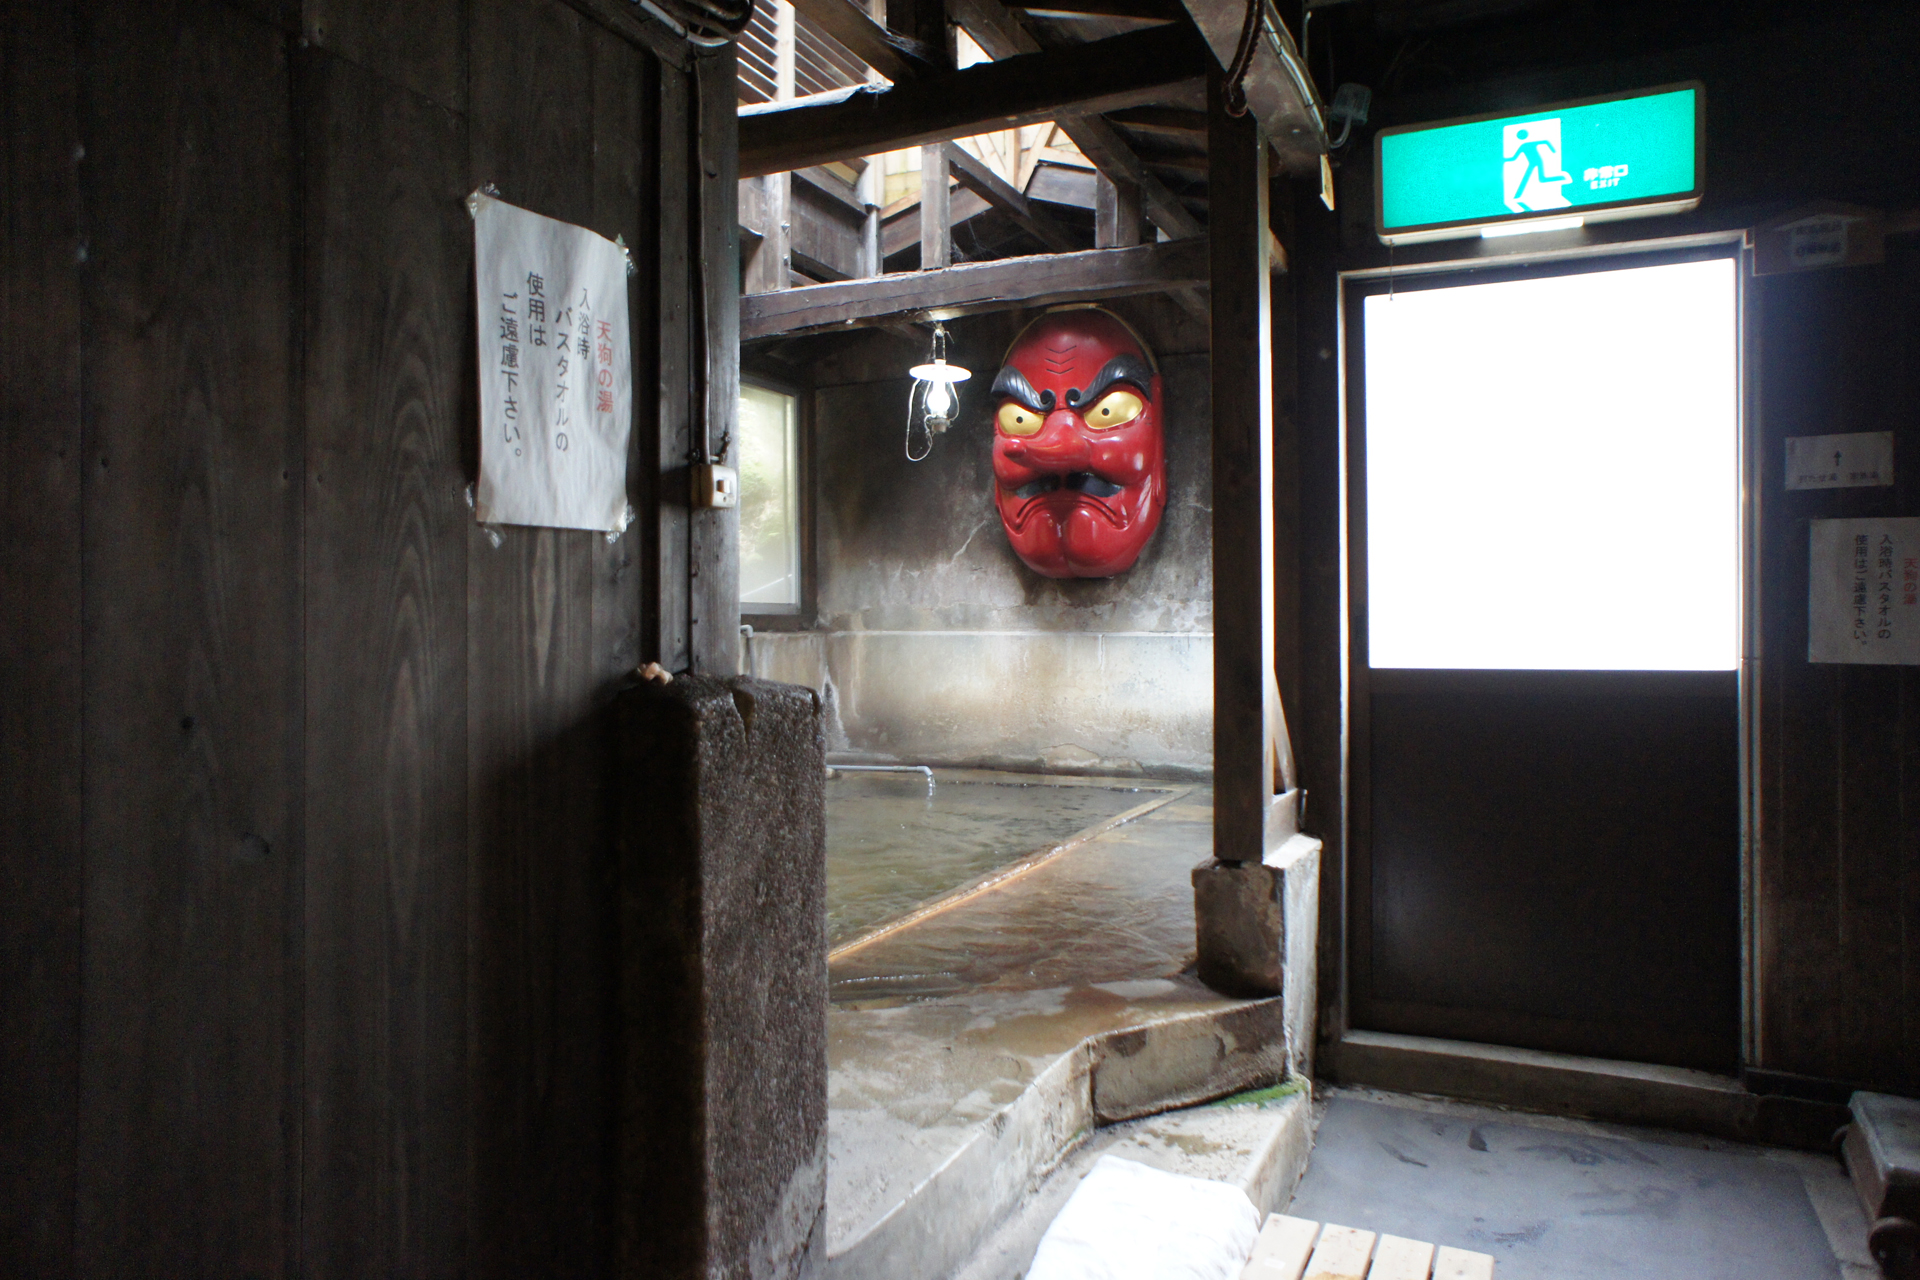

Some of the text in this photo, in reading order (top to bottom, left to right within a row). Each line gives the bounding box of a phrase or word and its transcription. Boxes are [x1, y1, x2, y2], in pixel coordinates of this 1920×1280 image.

[1590, 177, 1620, 190] EXIT
[526, 270, 547, 348] 使用は
[577, 287, 591, 361] 入浴時
[500, 292, 522, 458] ご遠慮下さい。
[555, 306, 573, 453] バスタオルの
[596, 319, 614, 414] 天狗の湯
